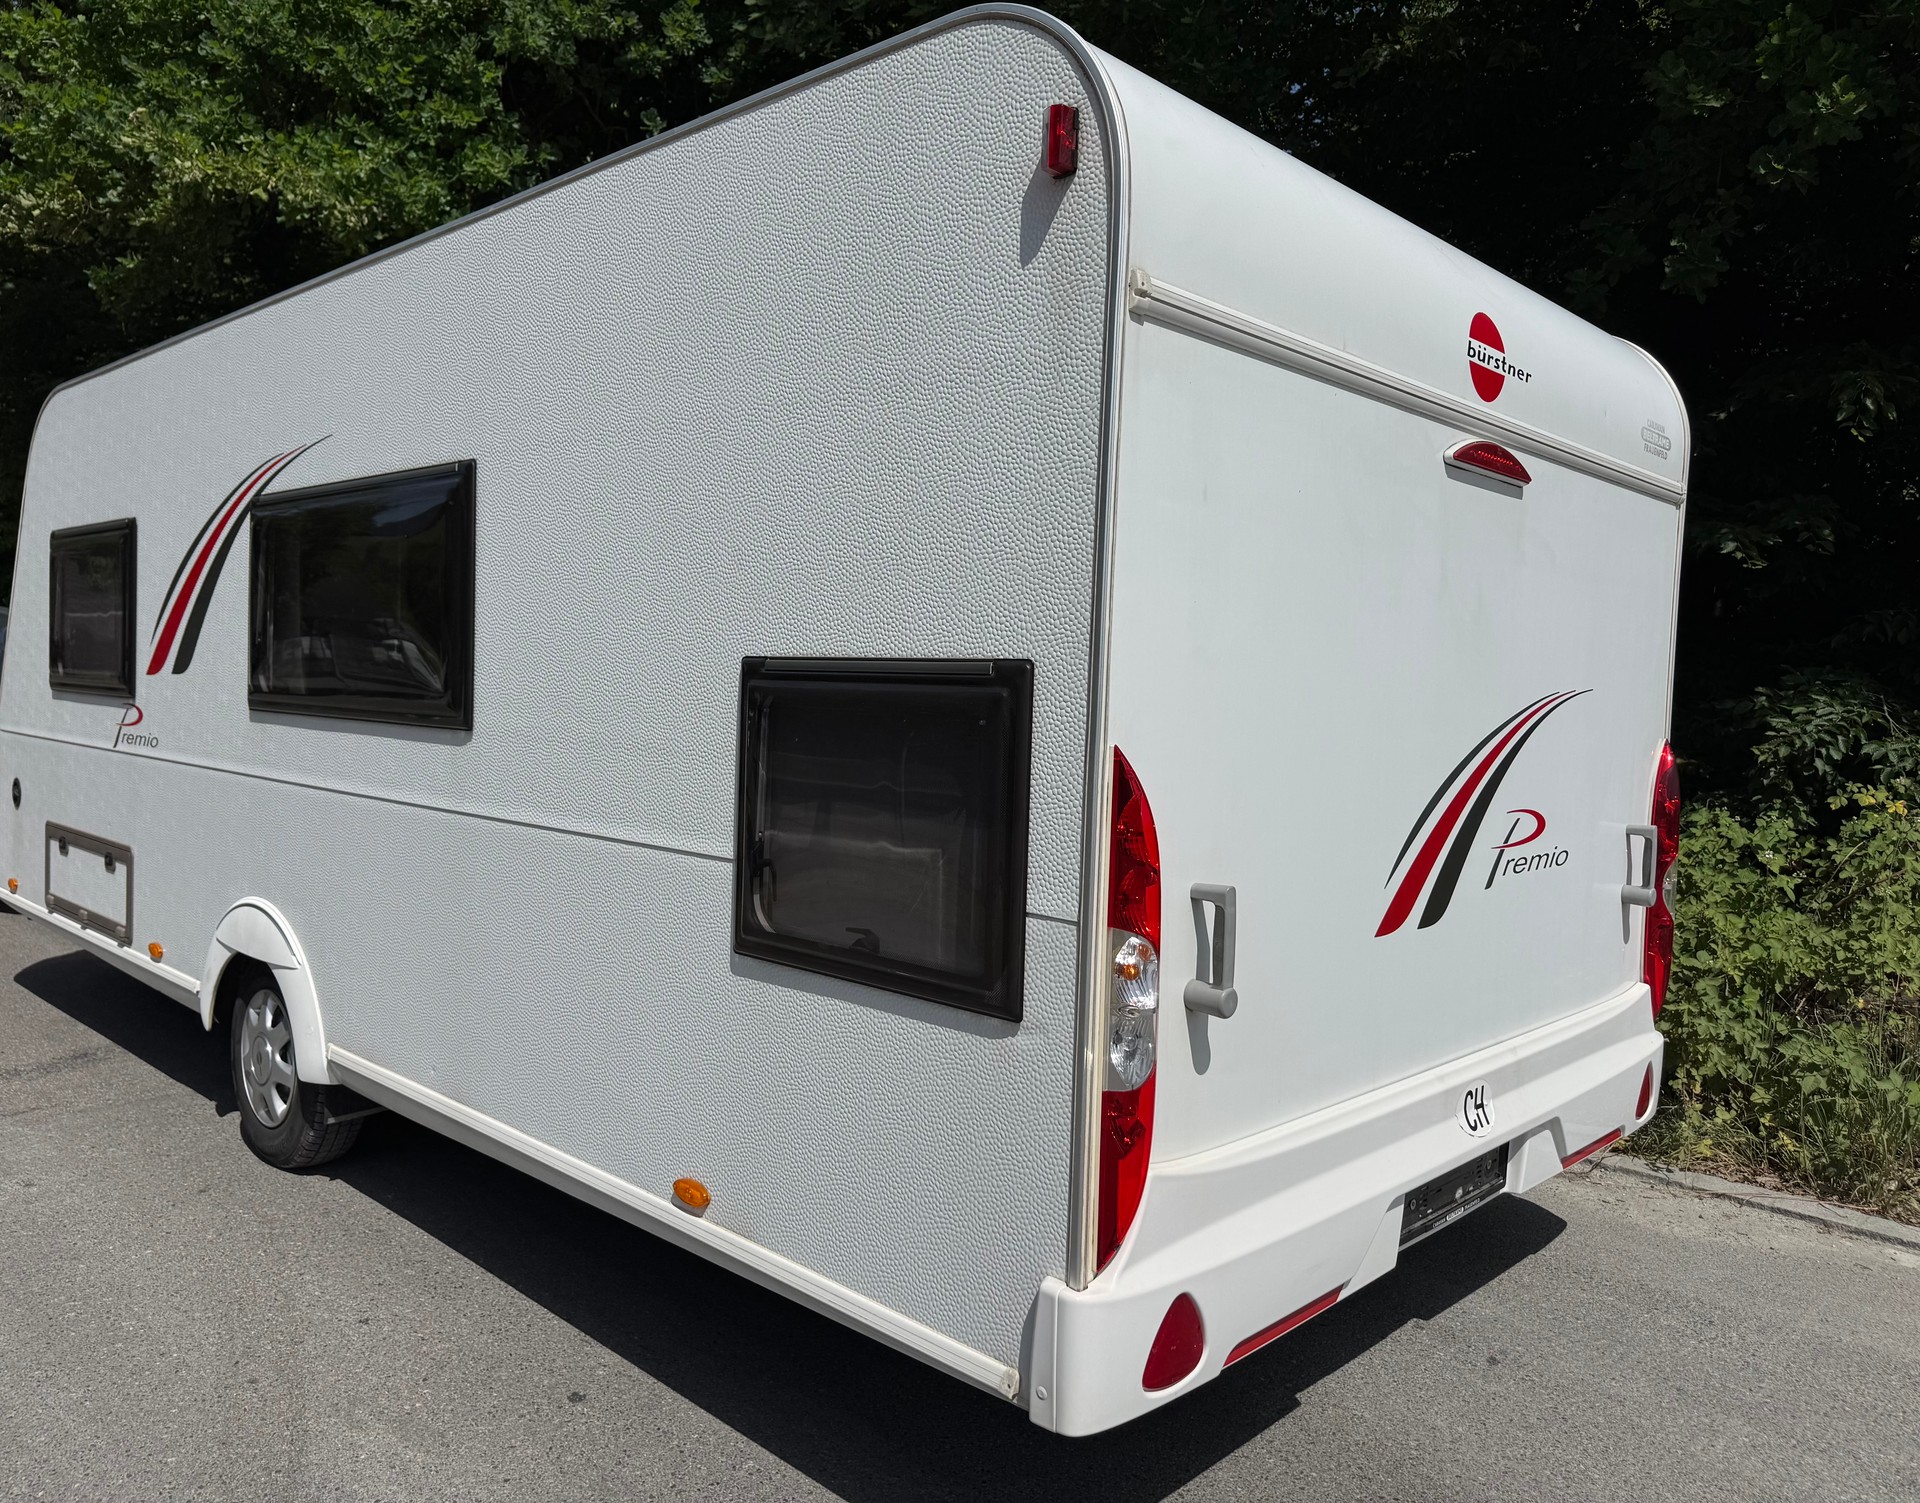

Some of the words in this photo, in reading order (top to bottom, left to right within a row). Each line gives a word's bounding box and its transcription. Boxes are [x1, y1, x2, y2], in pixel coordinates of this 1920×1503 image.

[1467, 340, 1532, 383] bürstner
[113, 703, 159, 748] Premio
[1485, 808, 1569, 890] Premio
[1463, 1084, 1490, 1132] CH
